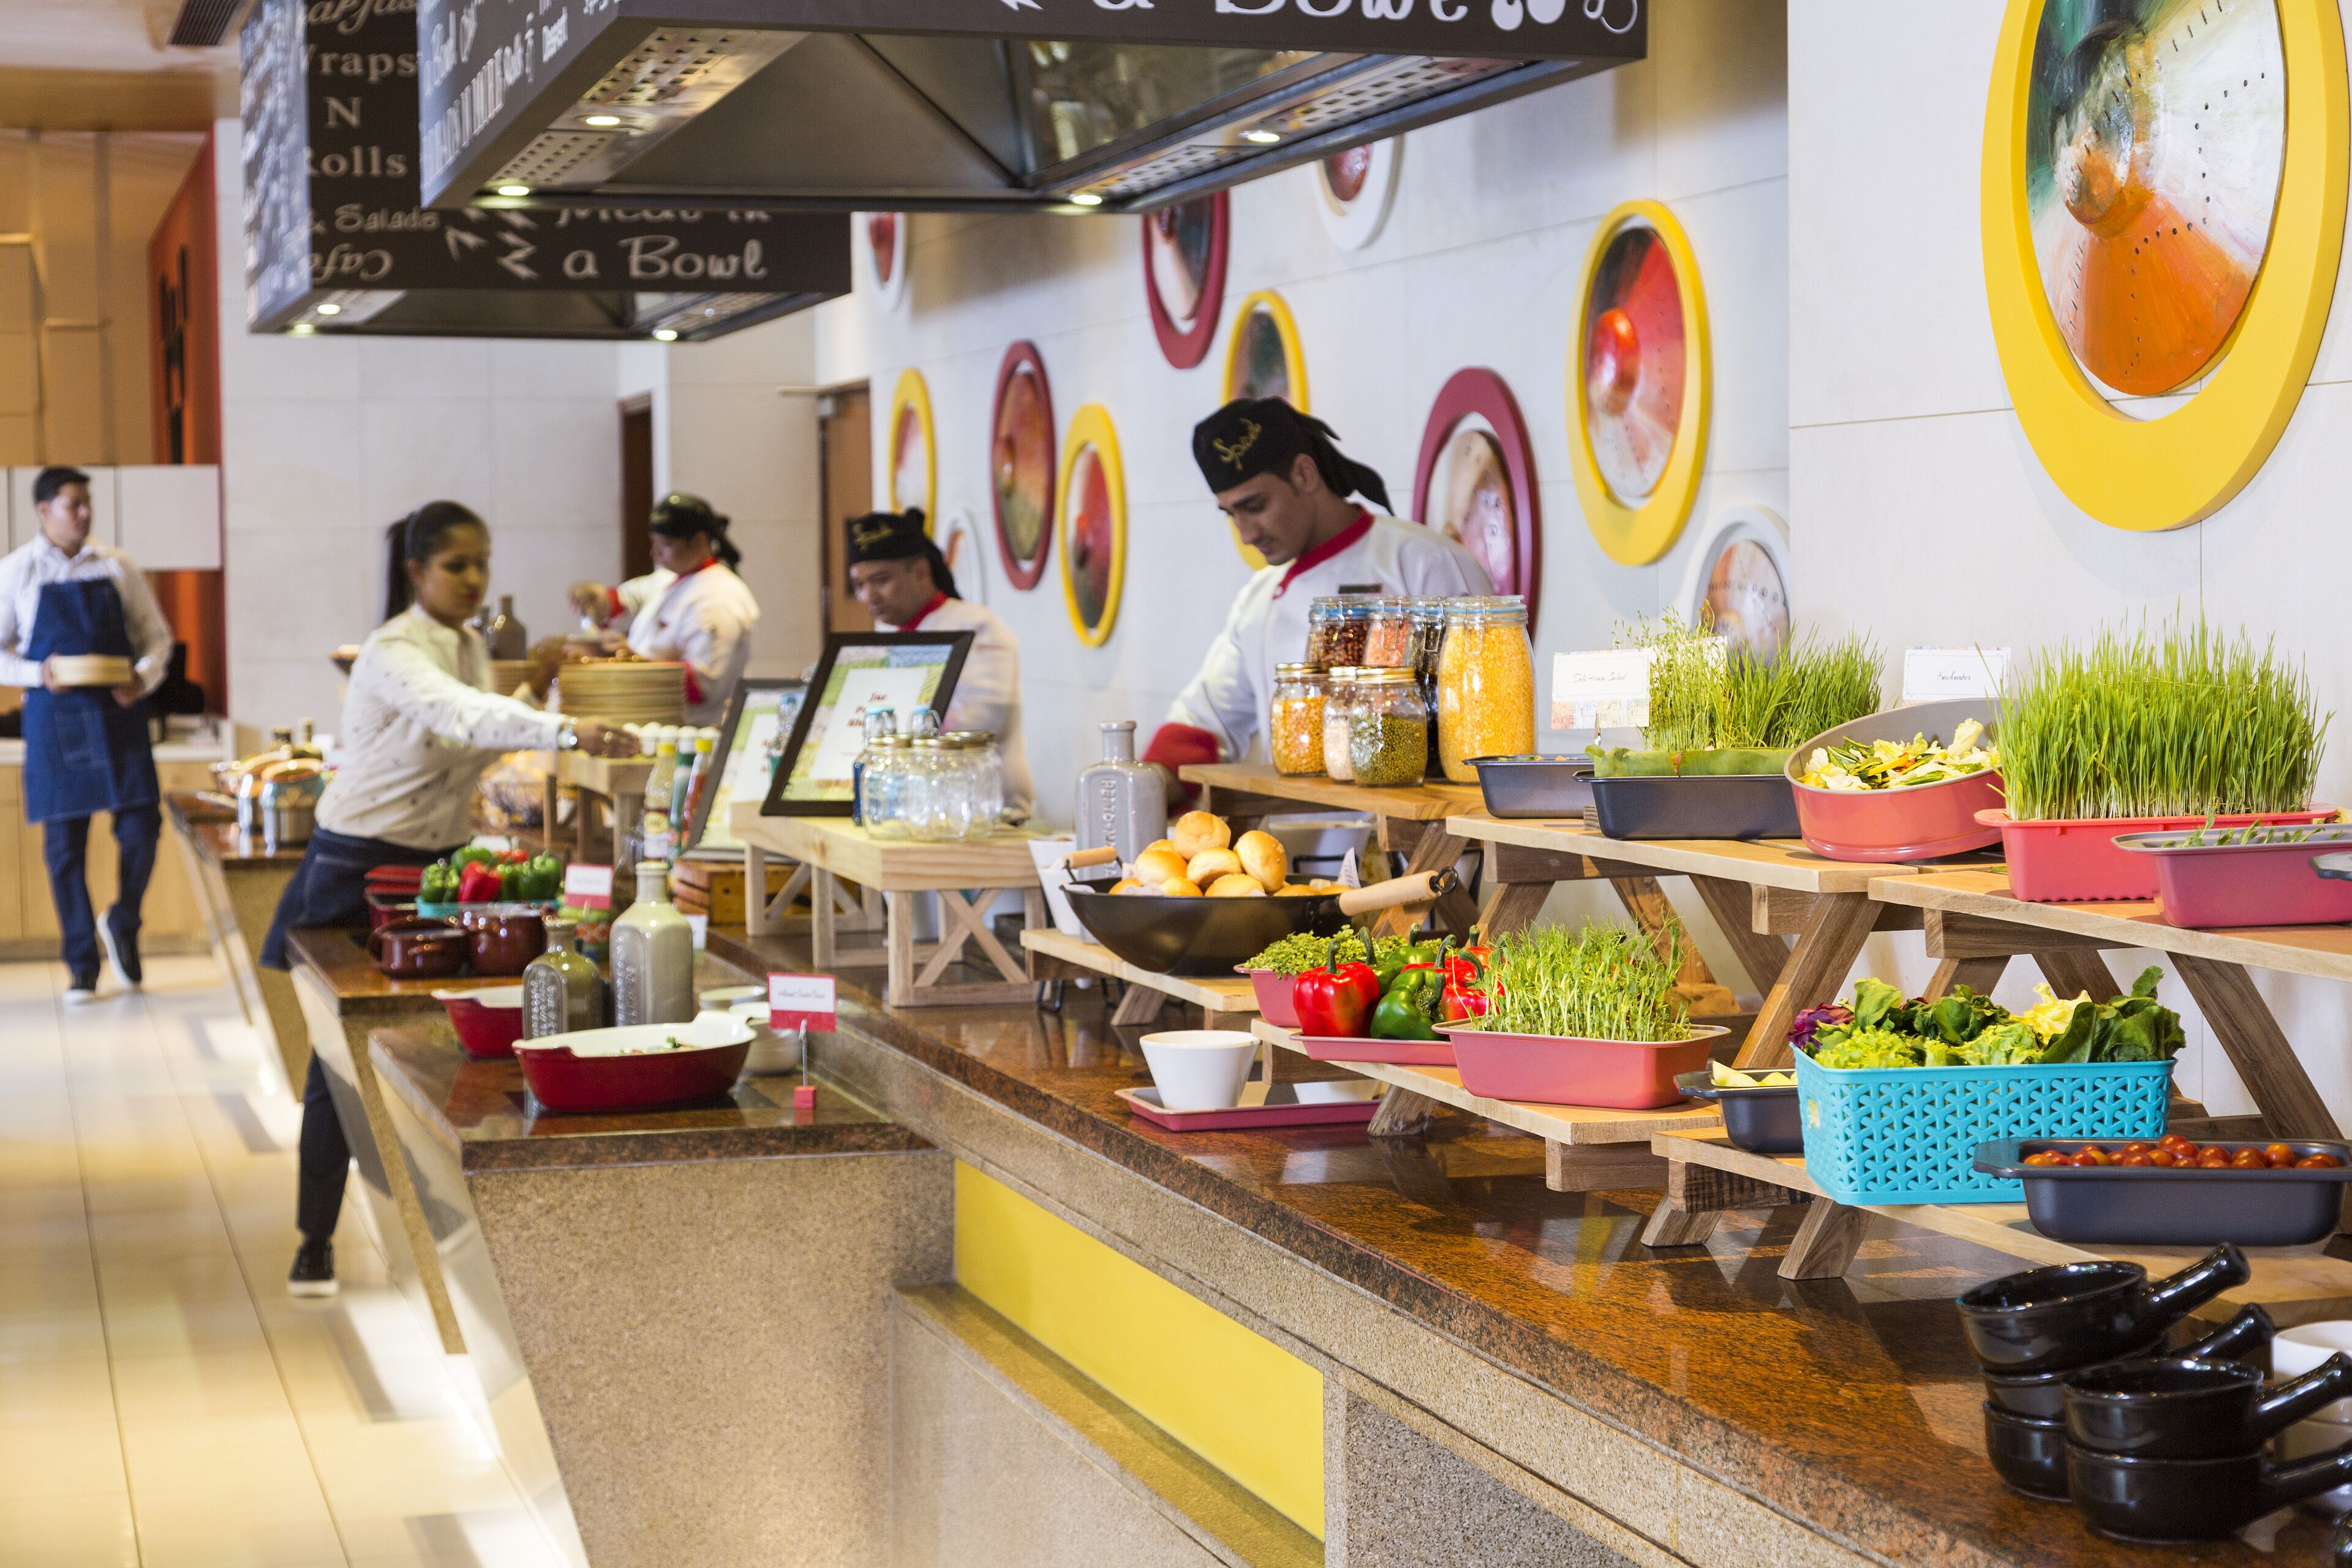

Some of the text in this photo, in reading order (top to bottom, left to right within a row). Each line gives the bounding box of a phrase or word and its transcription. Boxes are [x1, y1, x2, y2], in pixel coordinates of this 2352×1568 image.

[307, 43, 418, 84] raps
[323, 96, 362, 129] N
[562, 234, 768, 279] a Bowl
